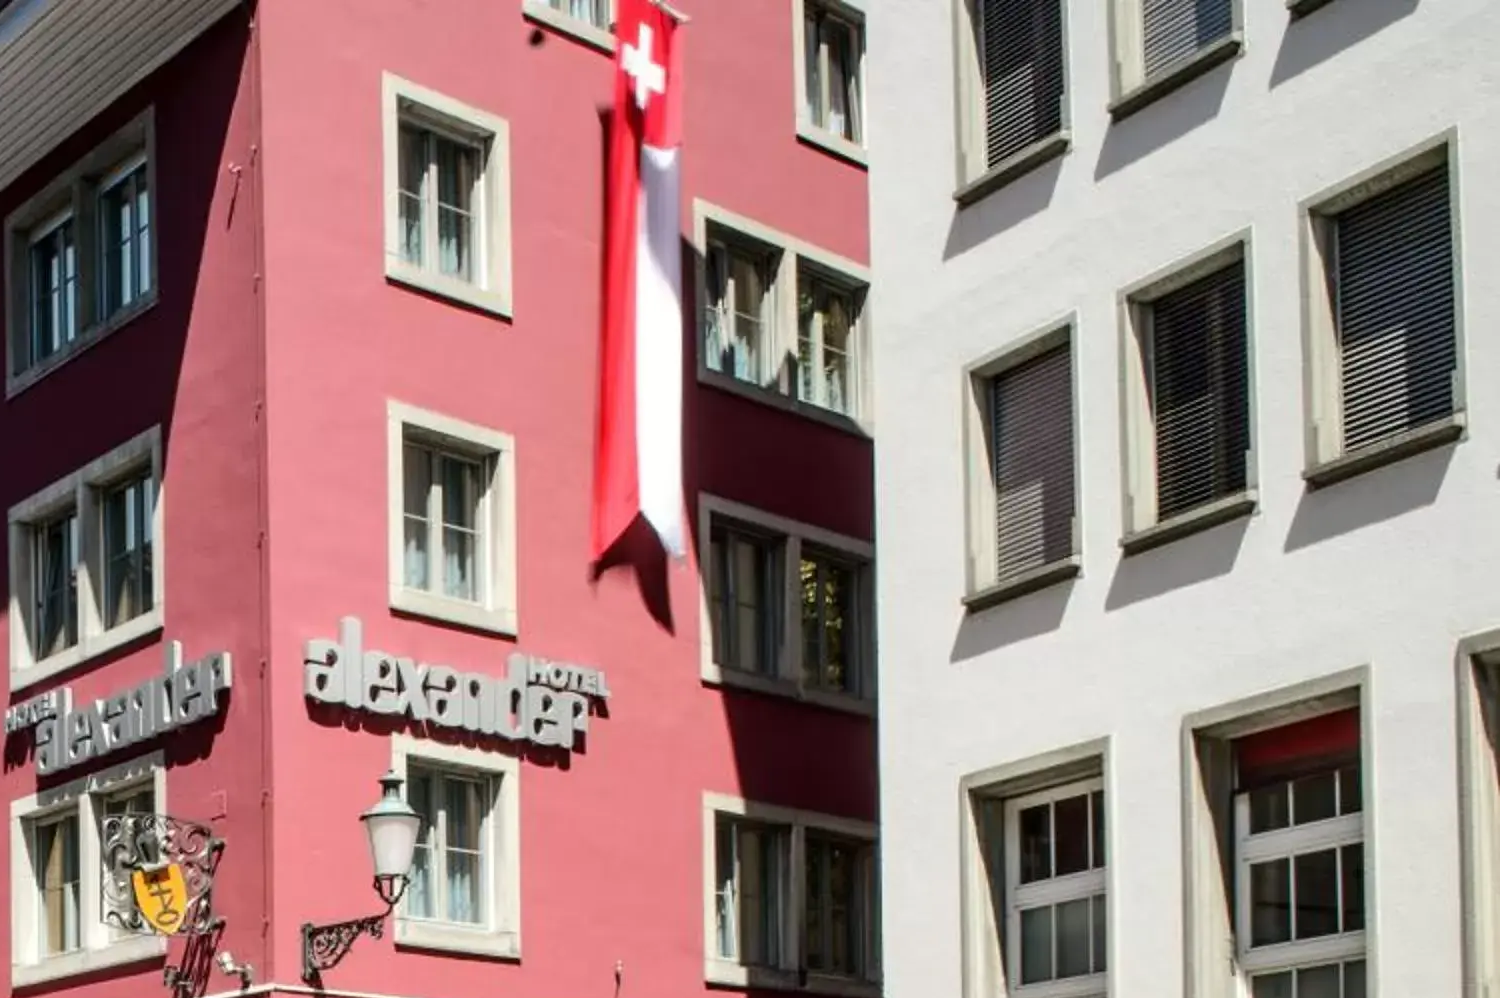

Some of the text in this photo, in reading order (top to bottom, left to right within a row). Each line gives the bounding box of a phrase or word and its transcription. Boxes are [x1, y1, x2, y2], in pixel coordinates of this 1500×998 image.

[5, 688, 57, 734] HOTEL
[35, 640, 232, 776] alexander
[304, 616, 588, 749] alexander
[527, 654, 611, 698] HOTEL
